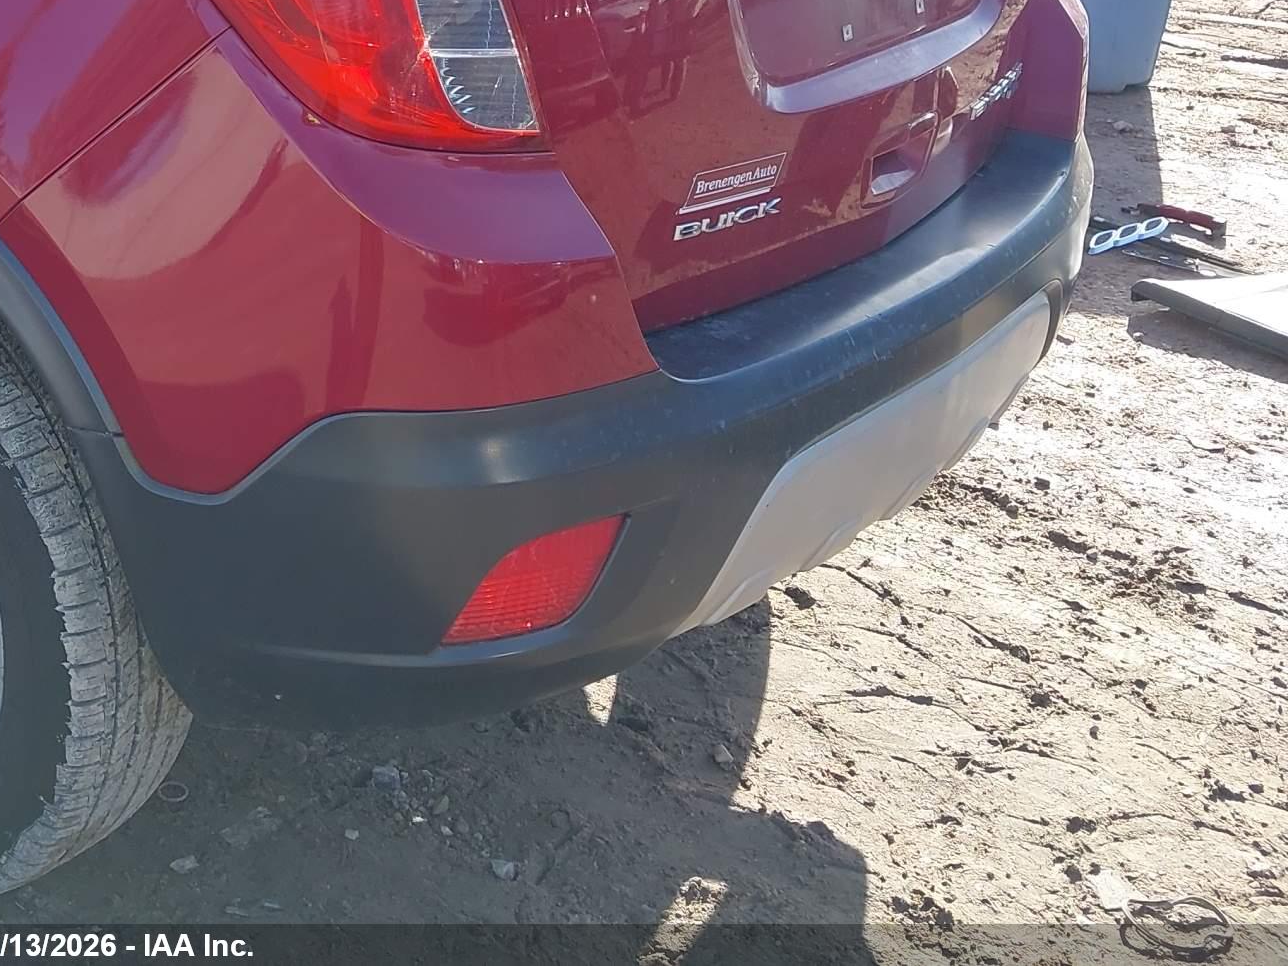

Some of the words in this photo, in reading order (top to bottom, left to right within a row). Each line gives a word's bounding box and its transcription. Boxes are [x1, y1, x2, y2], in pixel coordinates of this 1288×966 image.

[695, 171, 752, 194] Brenengen
[751, 164, 777, 179] Auto
[673, 197, 782, 241] BUICK
